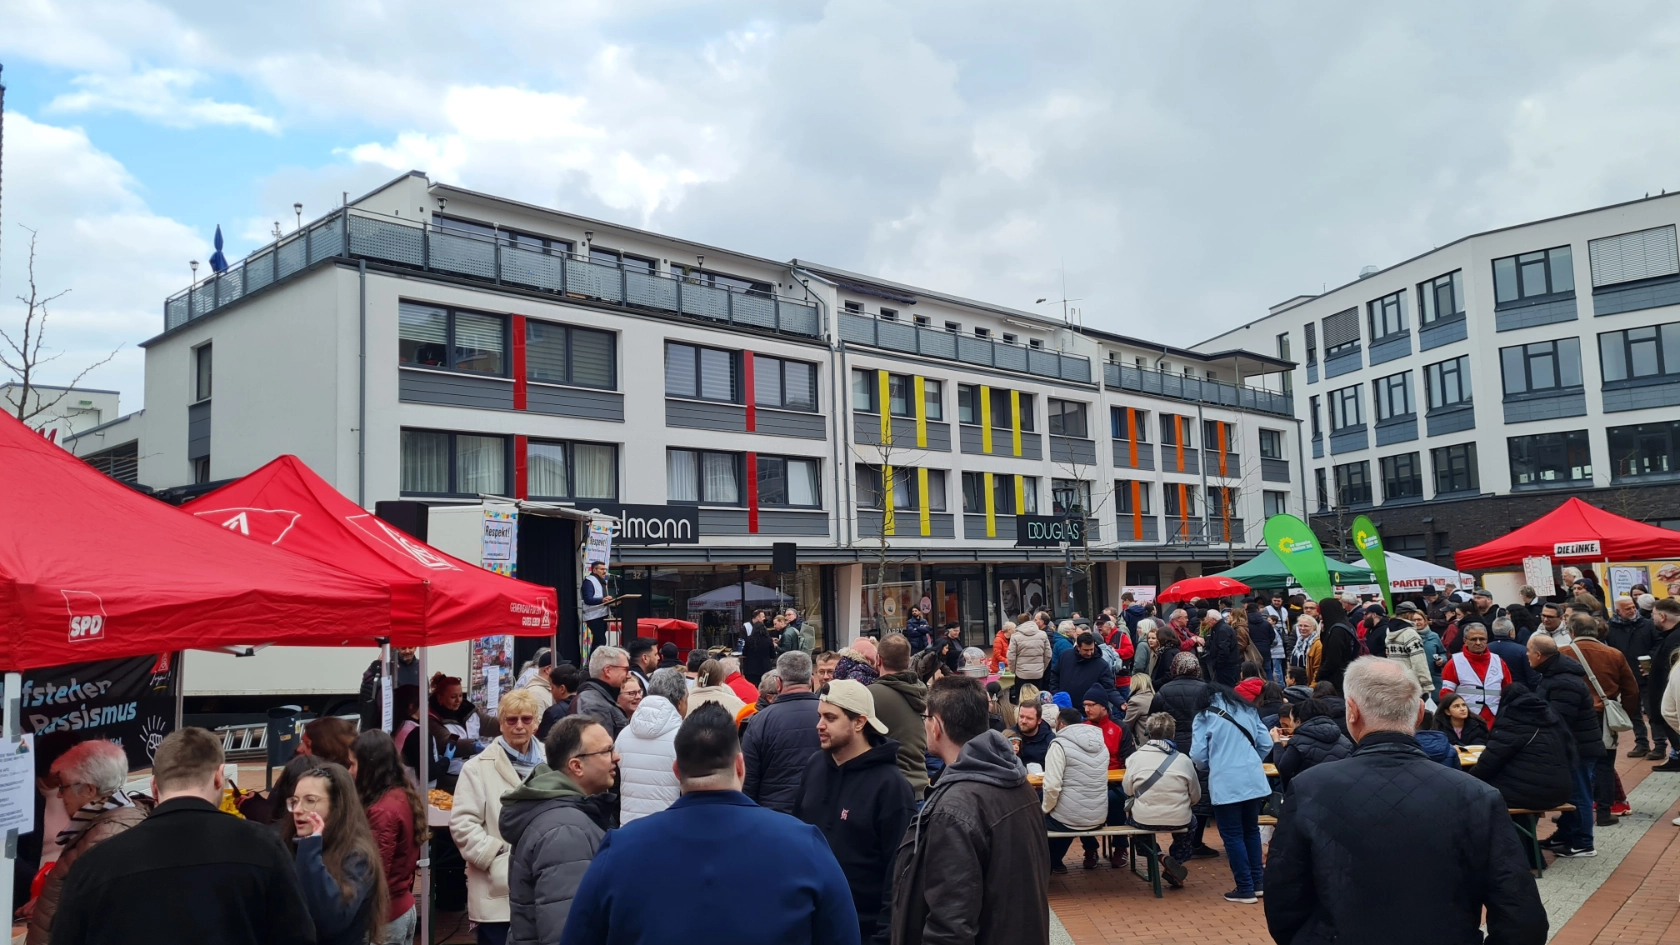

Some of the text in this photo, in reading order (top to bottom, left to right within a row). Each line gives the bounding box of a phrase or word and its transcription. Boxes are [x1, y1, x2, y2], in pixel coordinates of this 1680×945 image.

[485, 525, 511, 539] Respekt!
[586, 508, 691, 539] elmann
[1027, 521, 1080, 540] DOUGLAS
[1557, 545, 1570, 555] DIE
[632, 571, 642, 580] 32
[70, 614, 103, 637] SPD
[21, 677, 113, 708] fstehen
